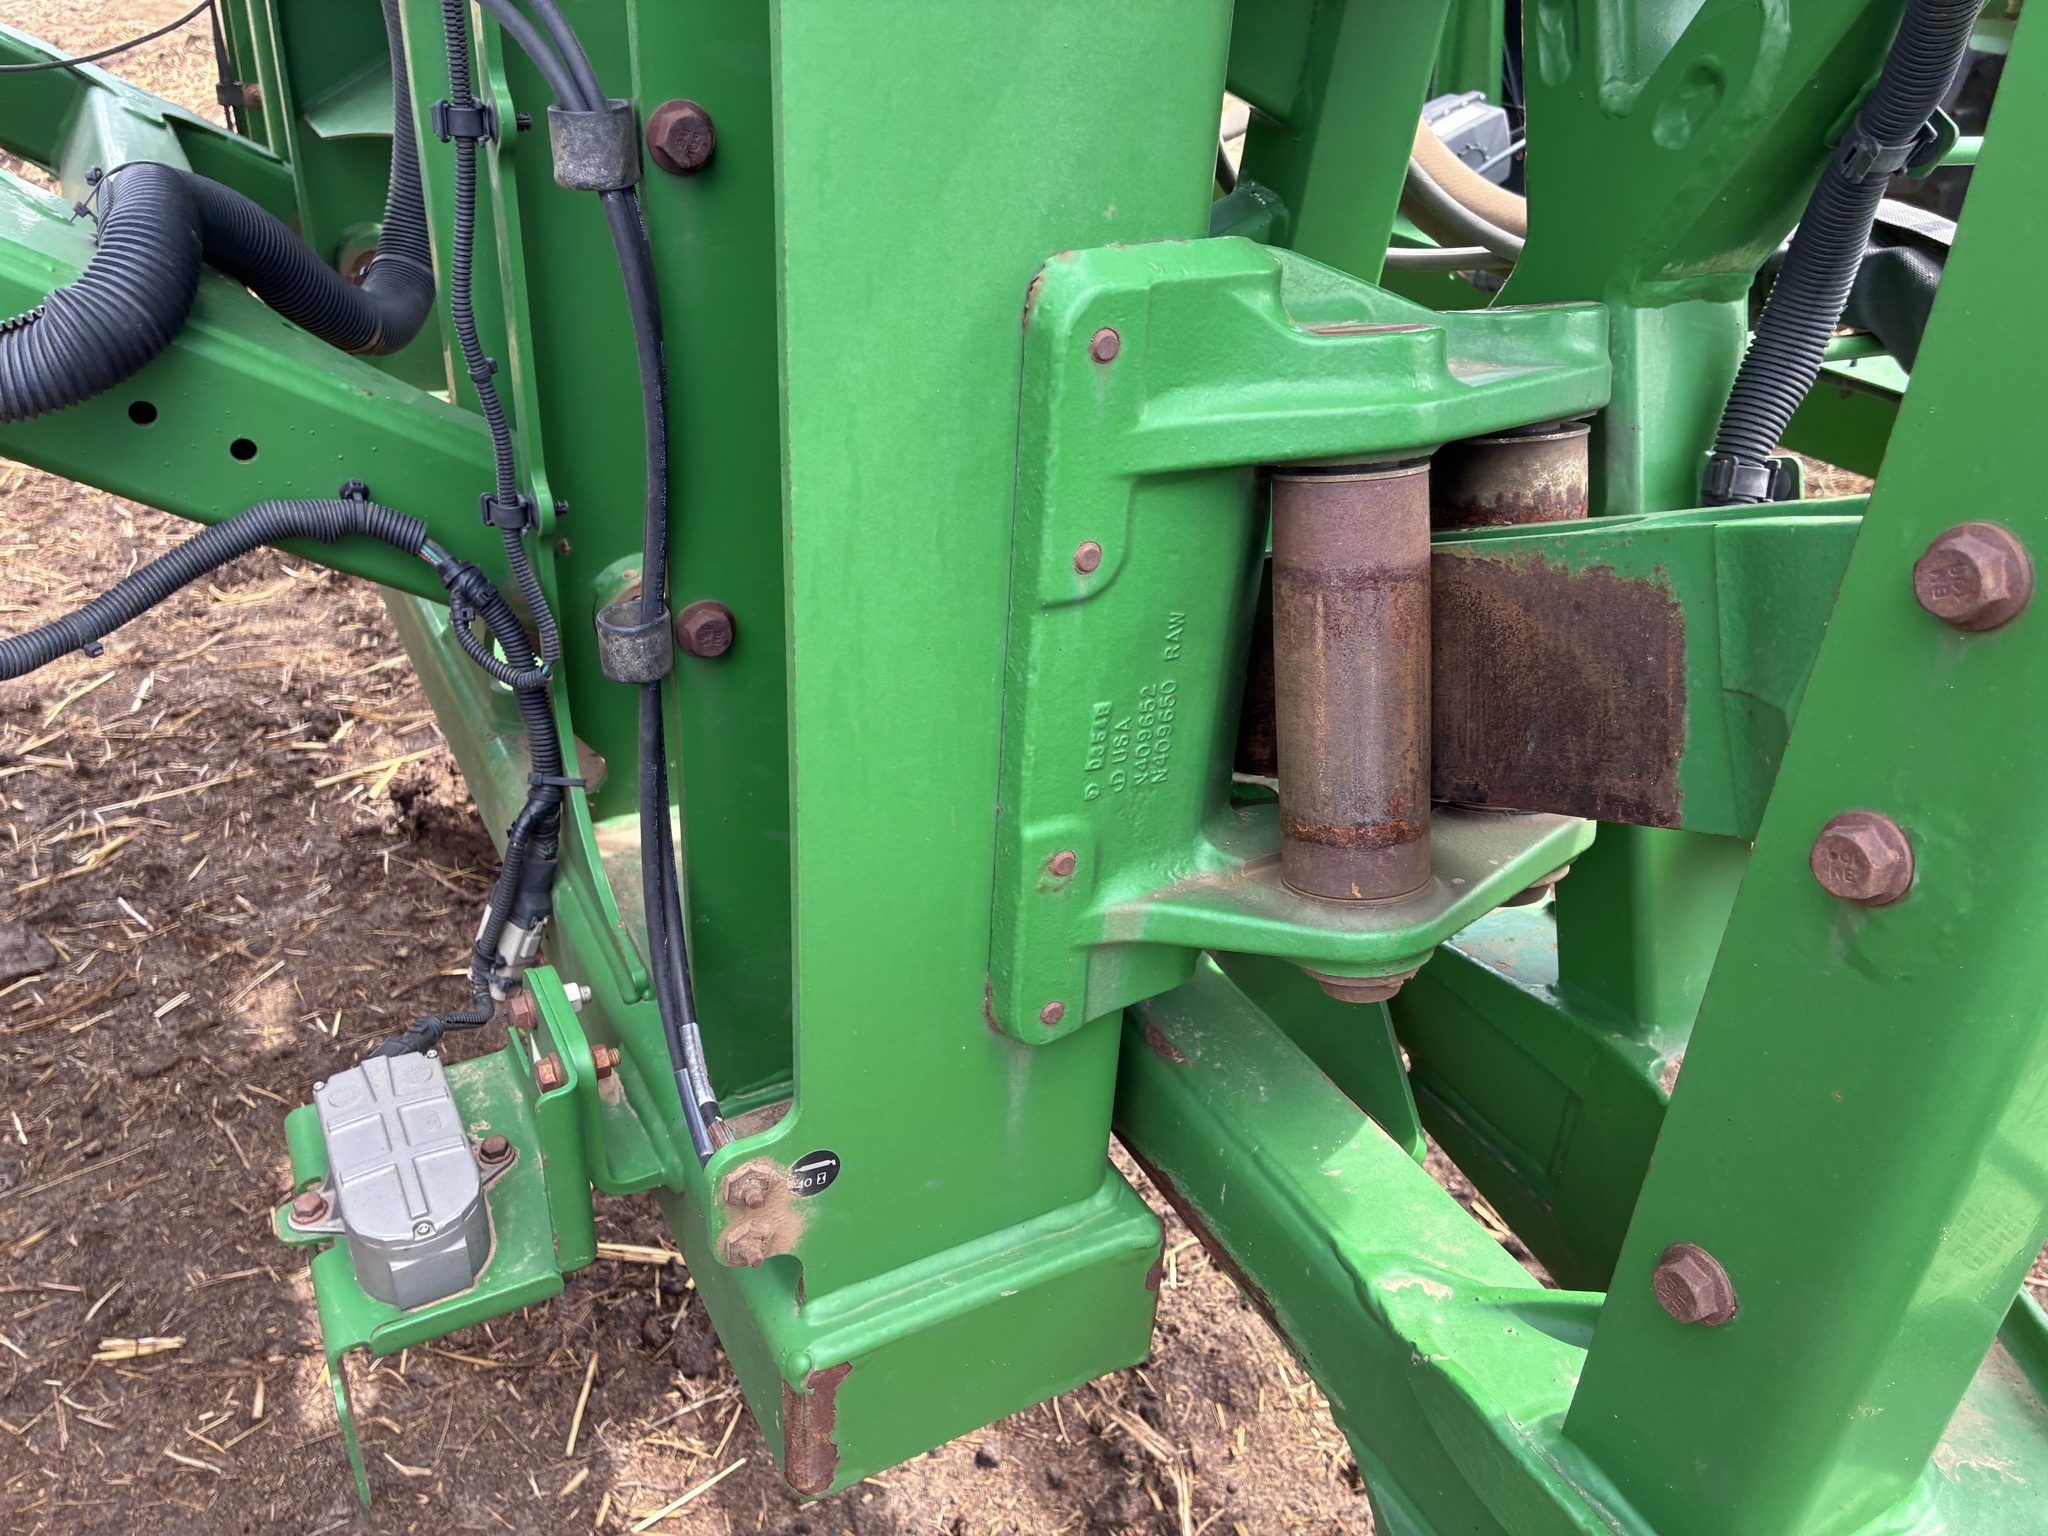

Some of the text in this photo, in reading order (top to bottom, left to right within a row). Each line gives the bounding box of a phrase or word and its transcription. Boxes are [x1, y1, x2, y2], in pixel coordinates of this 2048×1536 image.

[1112, 717, 1132, 764] USA
[1152, 612, 1186, 784] N409650 RAW
